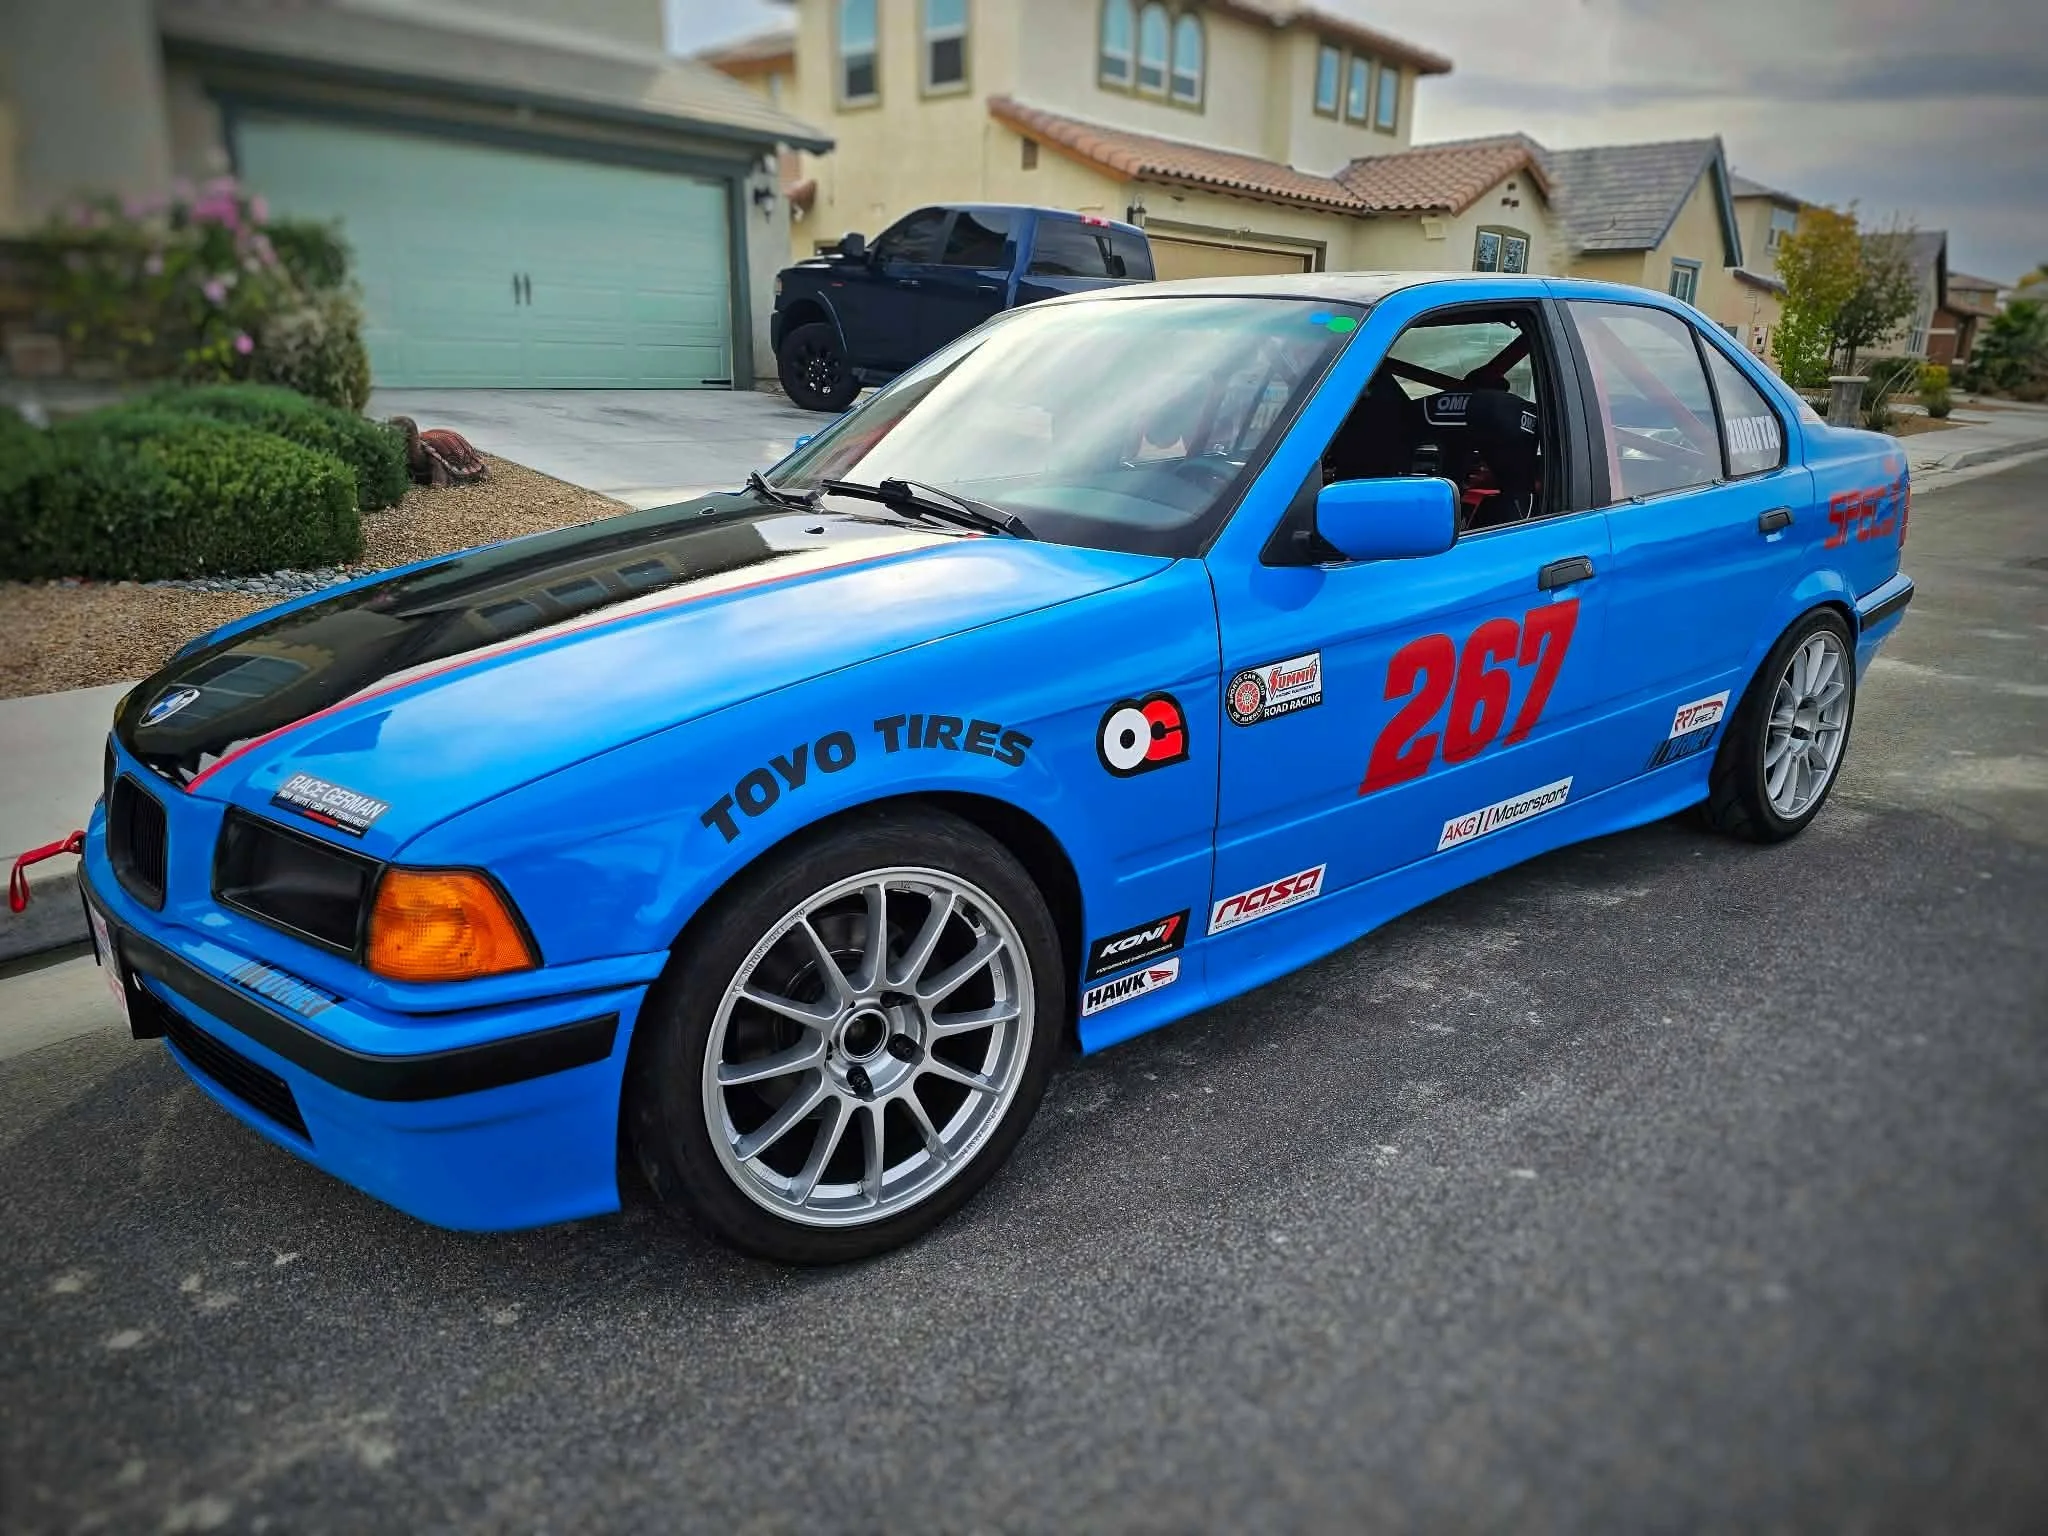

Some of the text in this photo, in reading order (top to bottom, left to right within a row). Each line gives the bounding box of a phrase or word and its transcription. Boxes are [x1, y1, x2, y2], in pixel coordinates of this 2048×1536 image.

[1269, 660, 1317, 700] SUMMIT
[1358, 598, 1580, 797] 267
[1264, 693, 1321, 718] ROAD RACING
[286, 775, 388, 819] RACE GERMAN
[701, 713, 1034, 844] TOYO TIRES
[1441, 785, 1568, 844] AKG Motorsport
[1100, 925, 1167, 958] KONI
[1087, 971, 1147, 1008] HAWK
